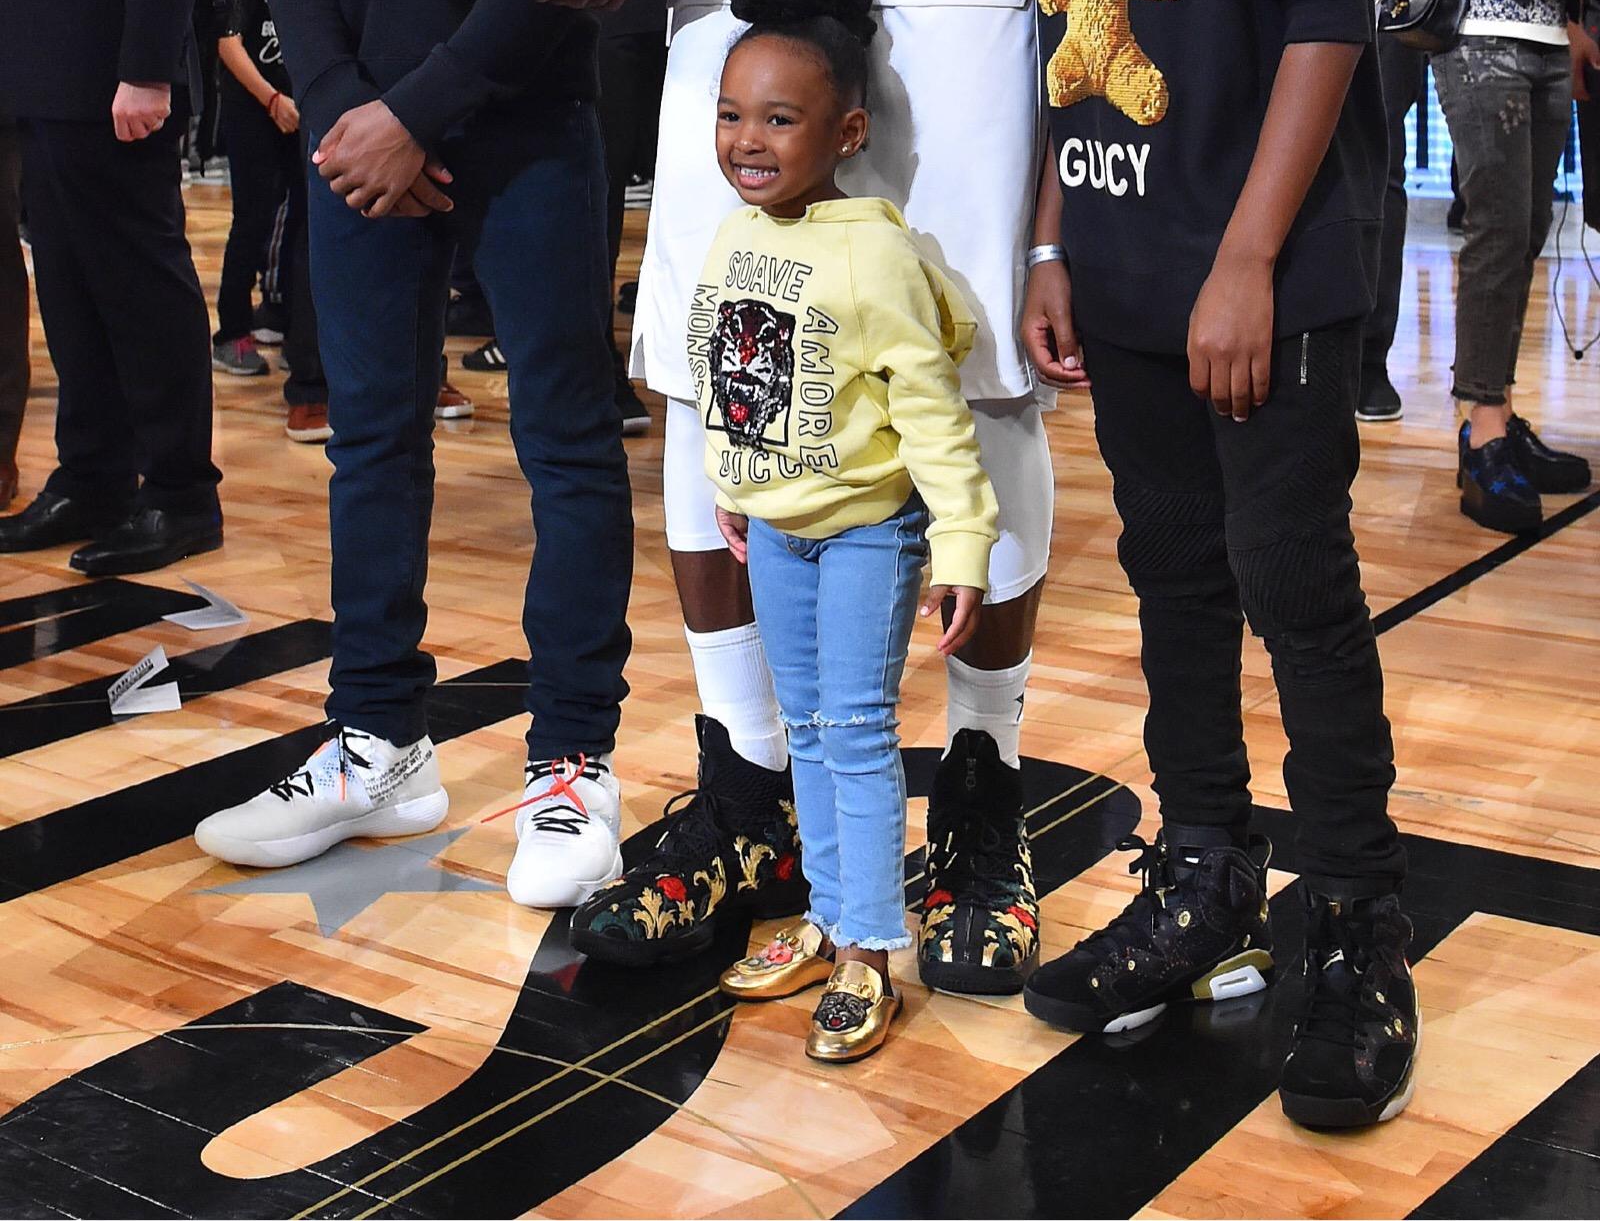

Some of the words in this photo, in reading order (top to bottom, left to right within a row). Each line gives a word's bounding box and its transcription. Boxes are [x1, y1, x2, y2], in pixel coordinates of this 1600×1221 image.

[1059, 137, 1151, 197] GUCY
[725, 251, 813, 303] SOAVE
[798, 305, 840, 474] AMORE
